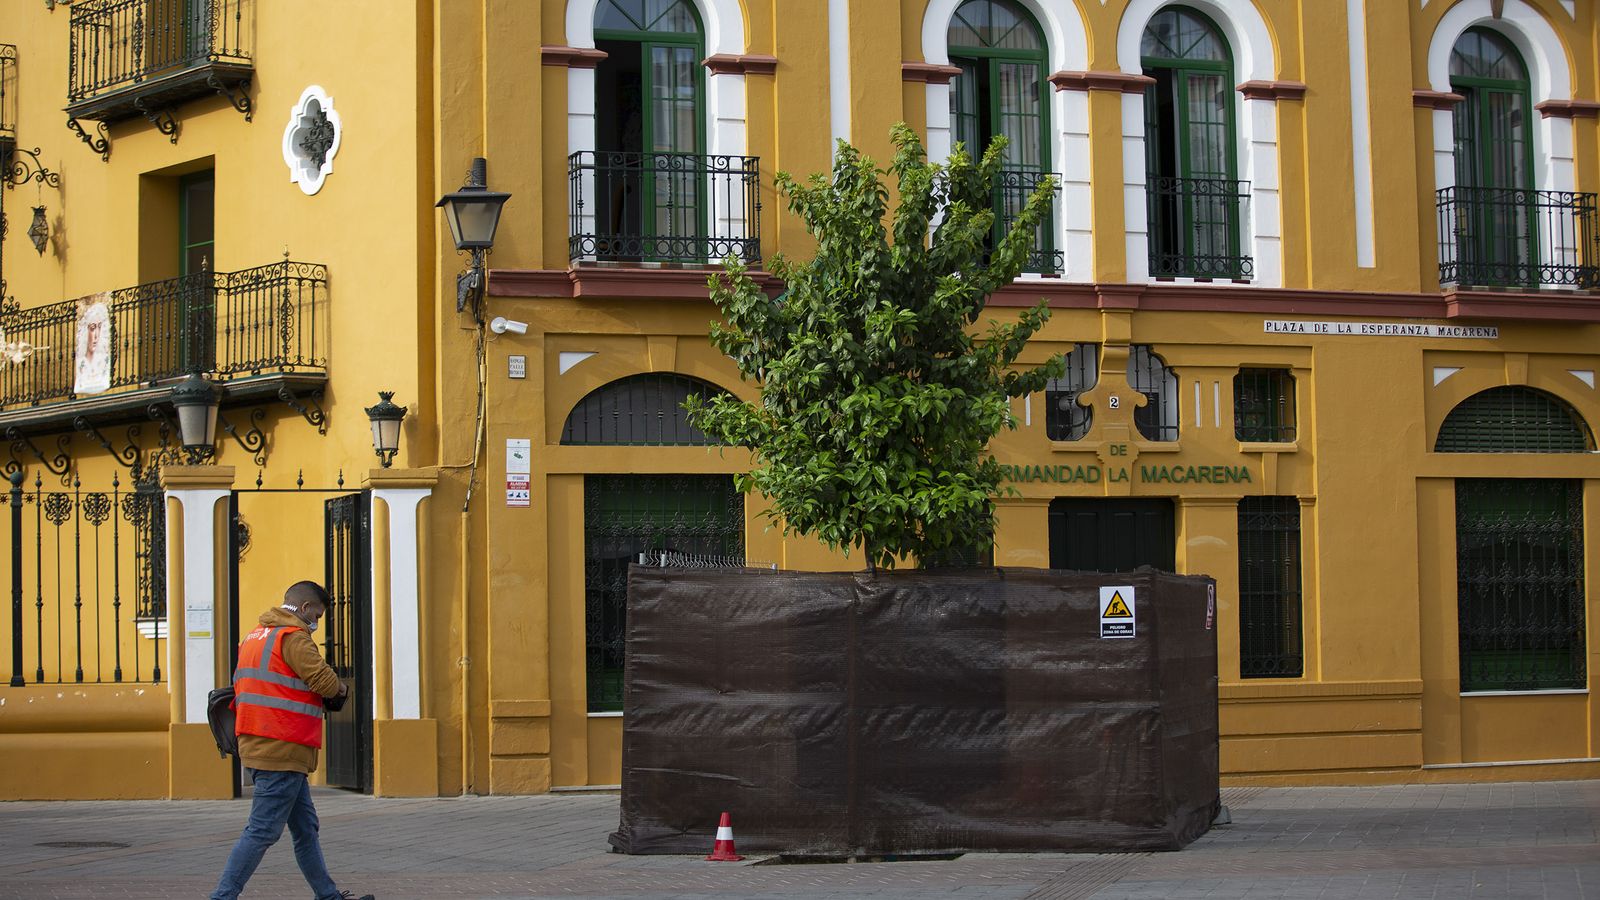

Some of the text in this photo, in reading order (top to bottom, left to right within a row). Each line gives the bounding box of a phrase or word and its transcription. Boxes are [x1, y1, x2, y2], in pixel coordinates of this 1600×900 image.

[1266, 322, 1498, 337] PLAZA DE LA ESPERANZA MACARENA
[1110, 397, 1118, 407] 2
[1110, 445, 1127, 456] DE
[1000, 464, 1252, 483] RMANDAD LA MACARENA
